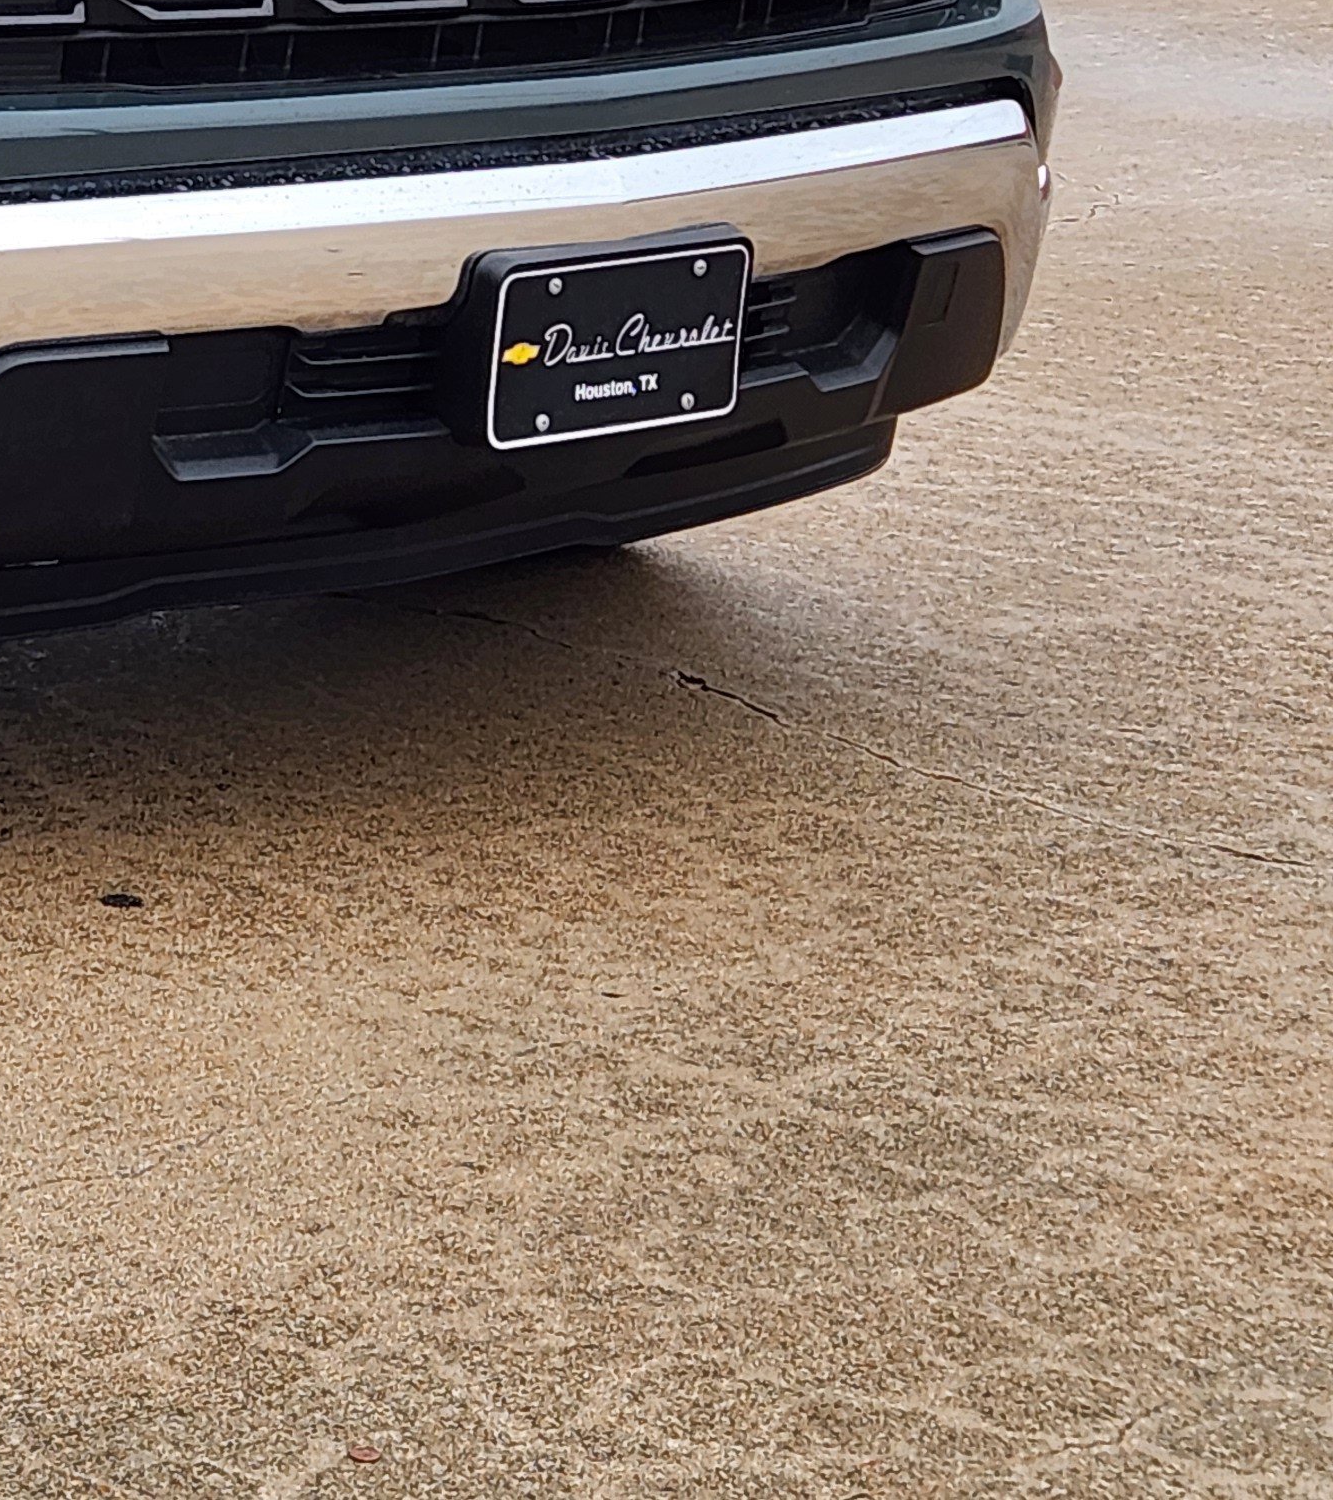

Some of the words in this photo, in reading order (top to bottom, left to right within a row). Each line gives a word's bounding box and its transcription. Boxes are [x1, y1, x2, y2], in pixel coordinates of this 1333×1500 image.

[544, 323, 614, 366] Davis
[615, 312, 736, 356] Chevrolet
[574, 380, 638, 402] Houston,
[638, 373, 659, 391] TX
